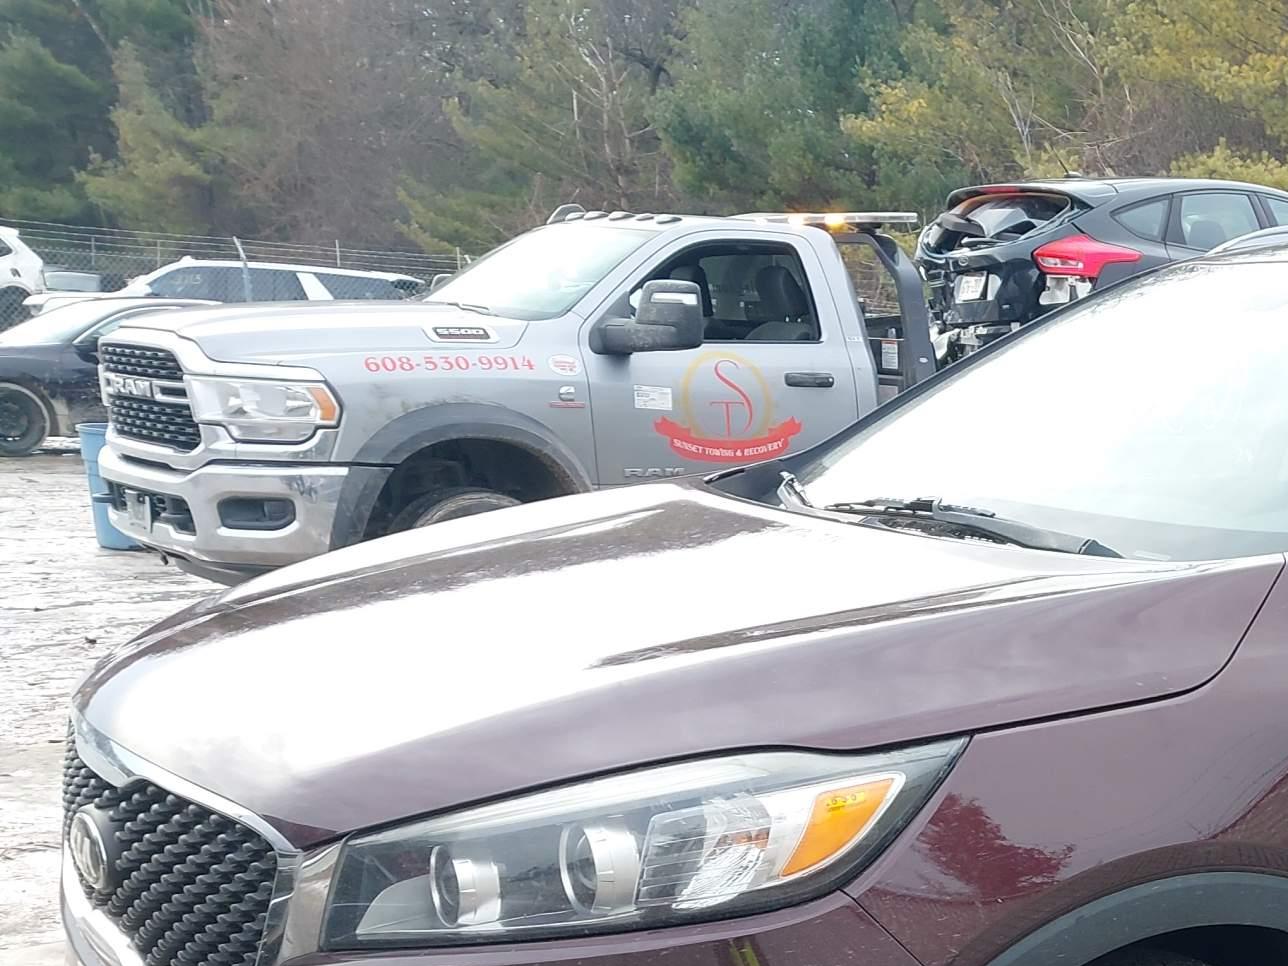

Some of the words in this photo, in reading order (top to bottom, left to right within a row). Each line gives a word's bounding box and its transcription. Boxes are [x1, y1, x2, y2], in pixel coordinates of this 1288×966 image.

[364, 355, 535, 373] 608-530-9914
[112, 377, 151, 397] RAM
[735, 448, 743, 456] &
[624, 468, 684, 477] RAM
